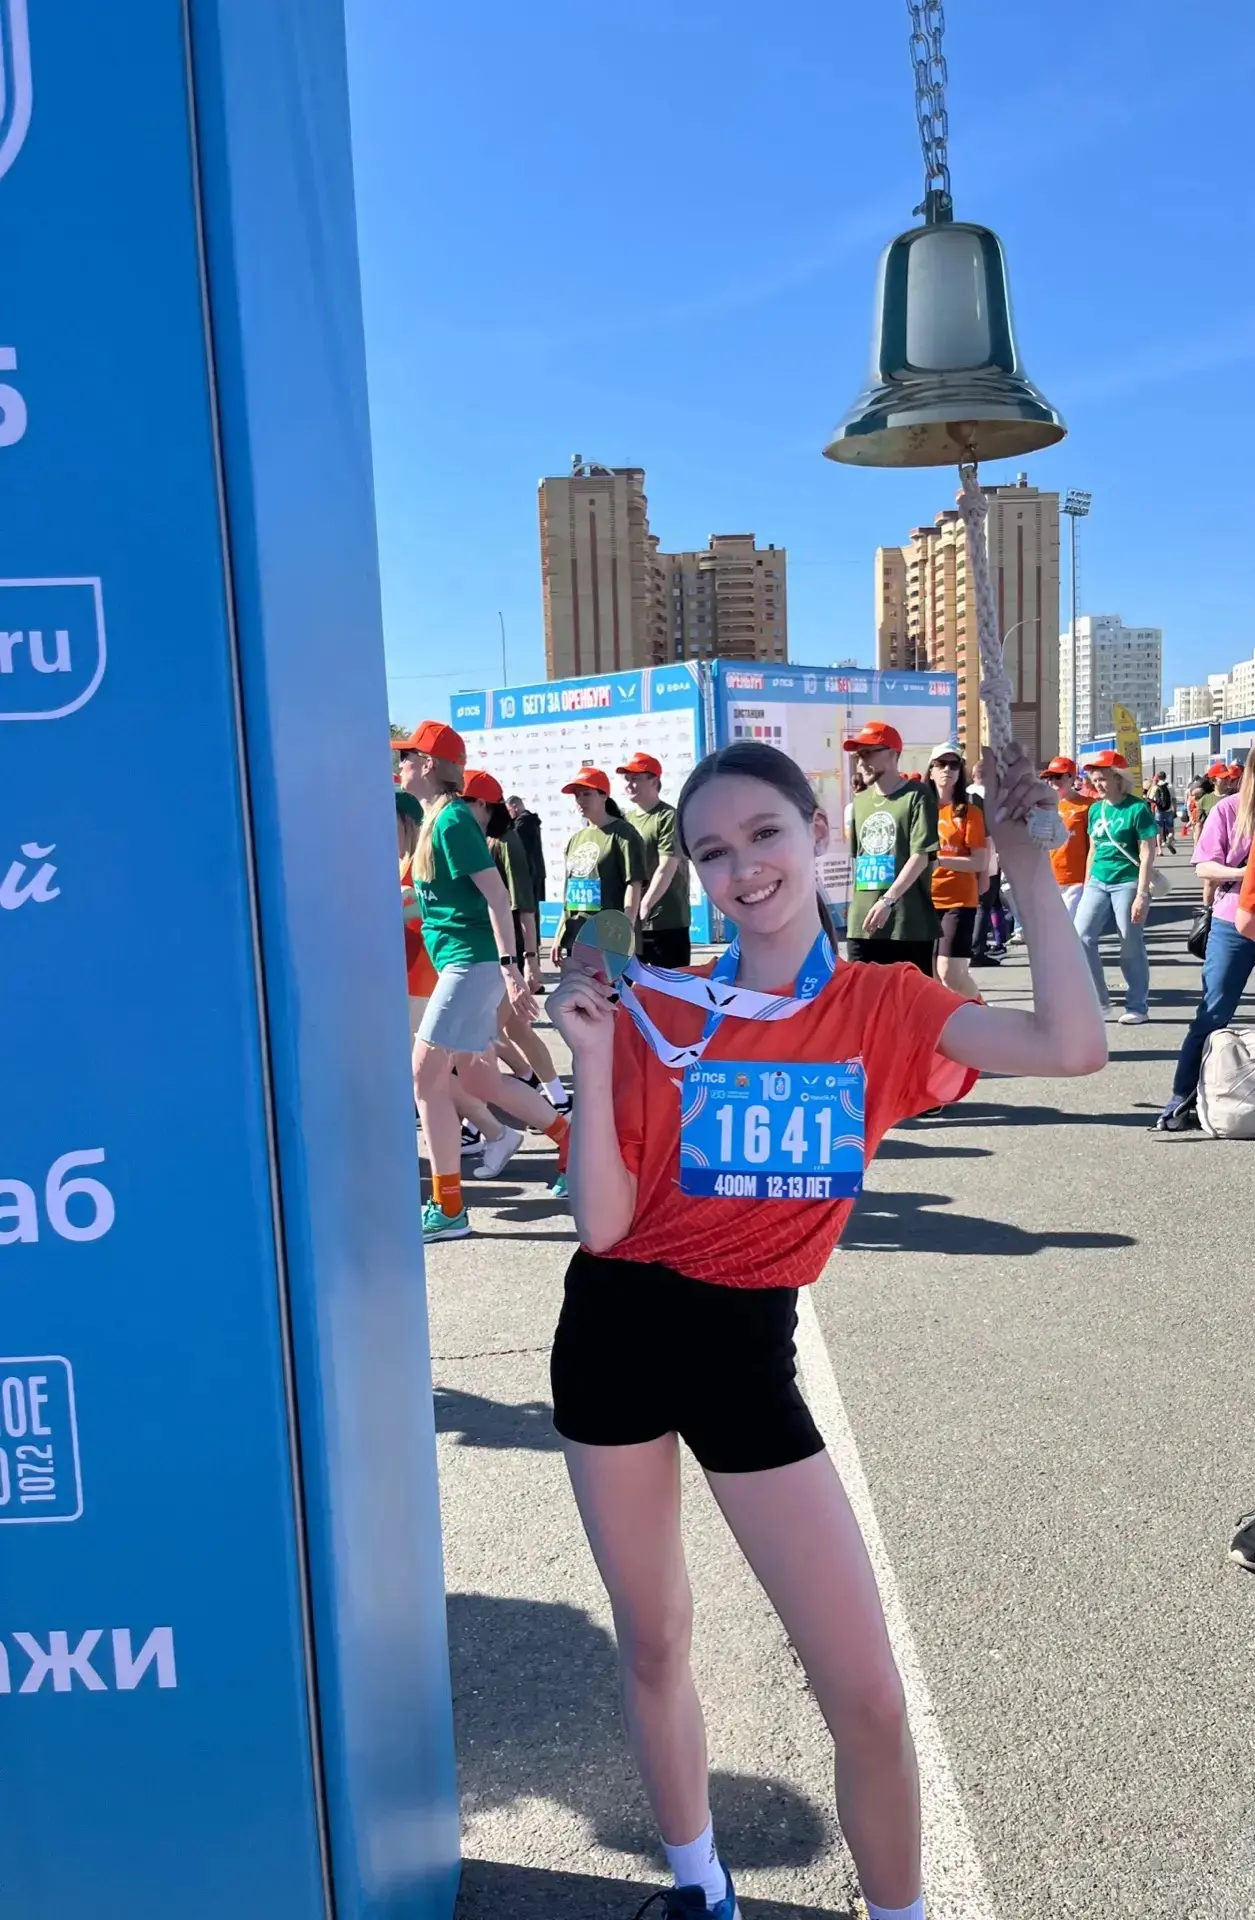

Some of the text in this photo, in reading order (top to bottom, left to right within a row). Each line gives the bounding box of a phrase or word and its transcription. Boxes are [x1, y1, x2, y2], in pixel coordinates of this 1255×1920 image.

[499, 696, 516, 719] 10
[523, 685, 612, 715] БЕГУ ЗА ОРЕНБУРГ
[861, 866, 886, 880] 1476
[702, 1073, 726, 1083] ПСБ
[759, 1072, 792, 1102] 10
[716, 1104, 832, 1164] 1641
[714, 1175, 832, 1198] 400М 12-13 ЛЕТ
[16, 1444, 57, 1504] 107.2
[0, 1627, 177, 1693] жи
